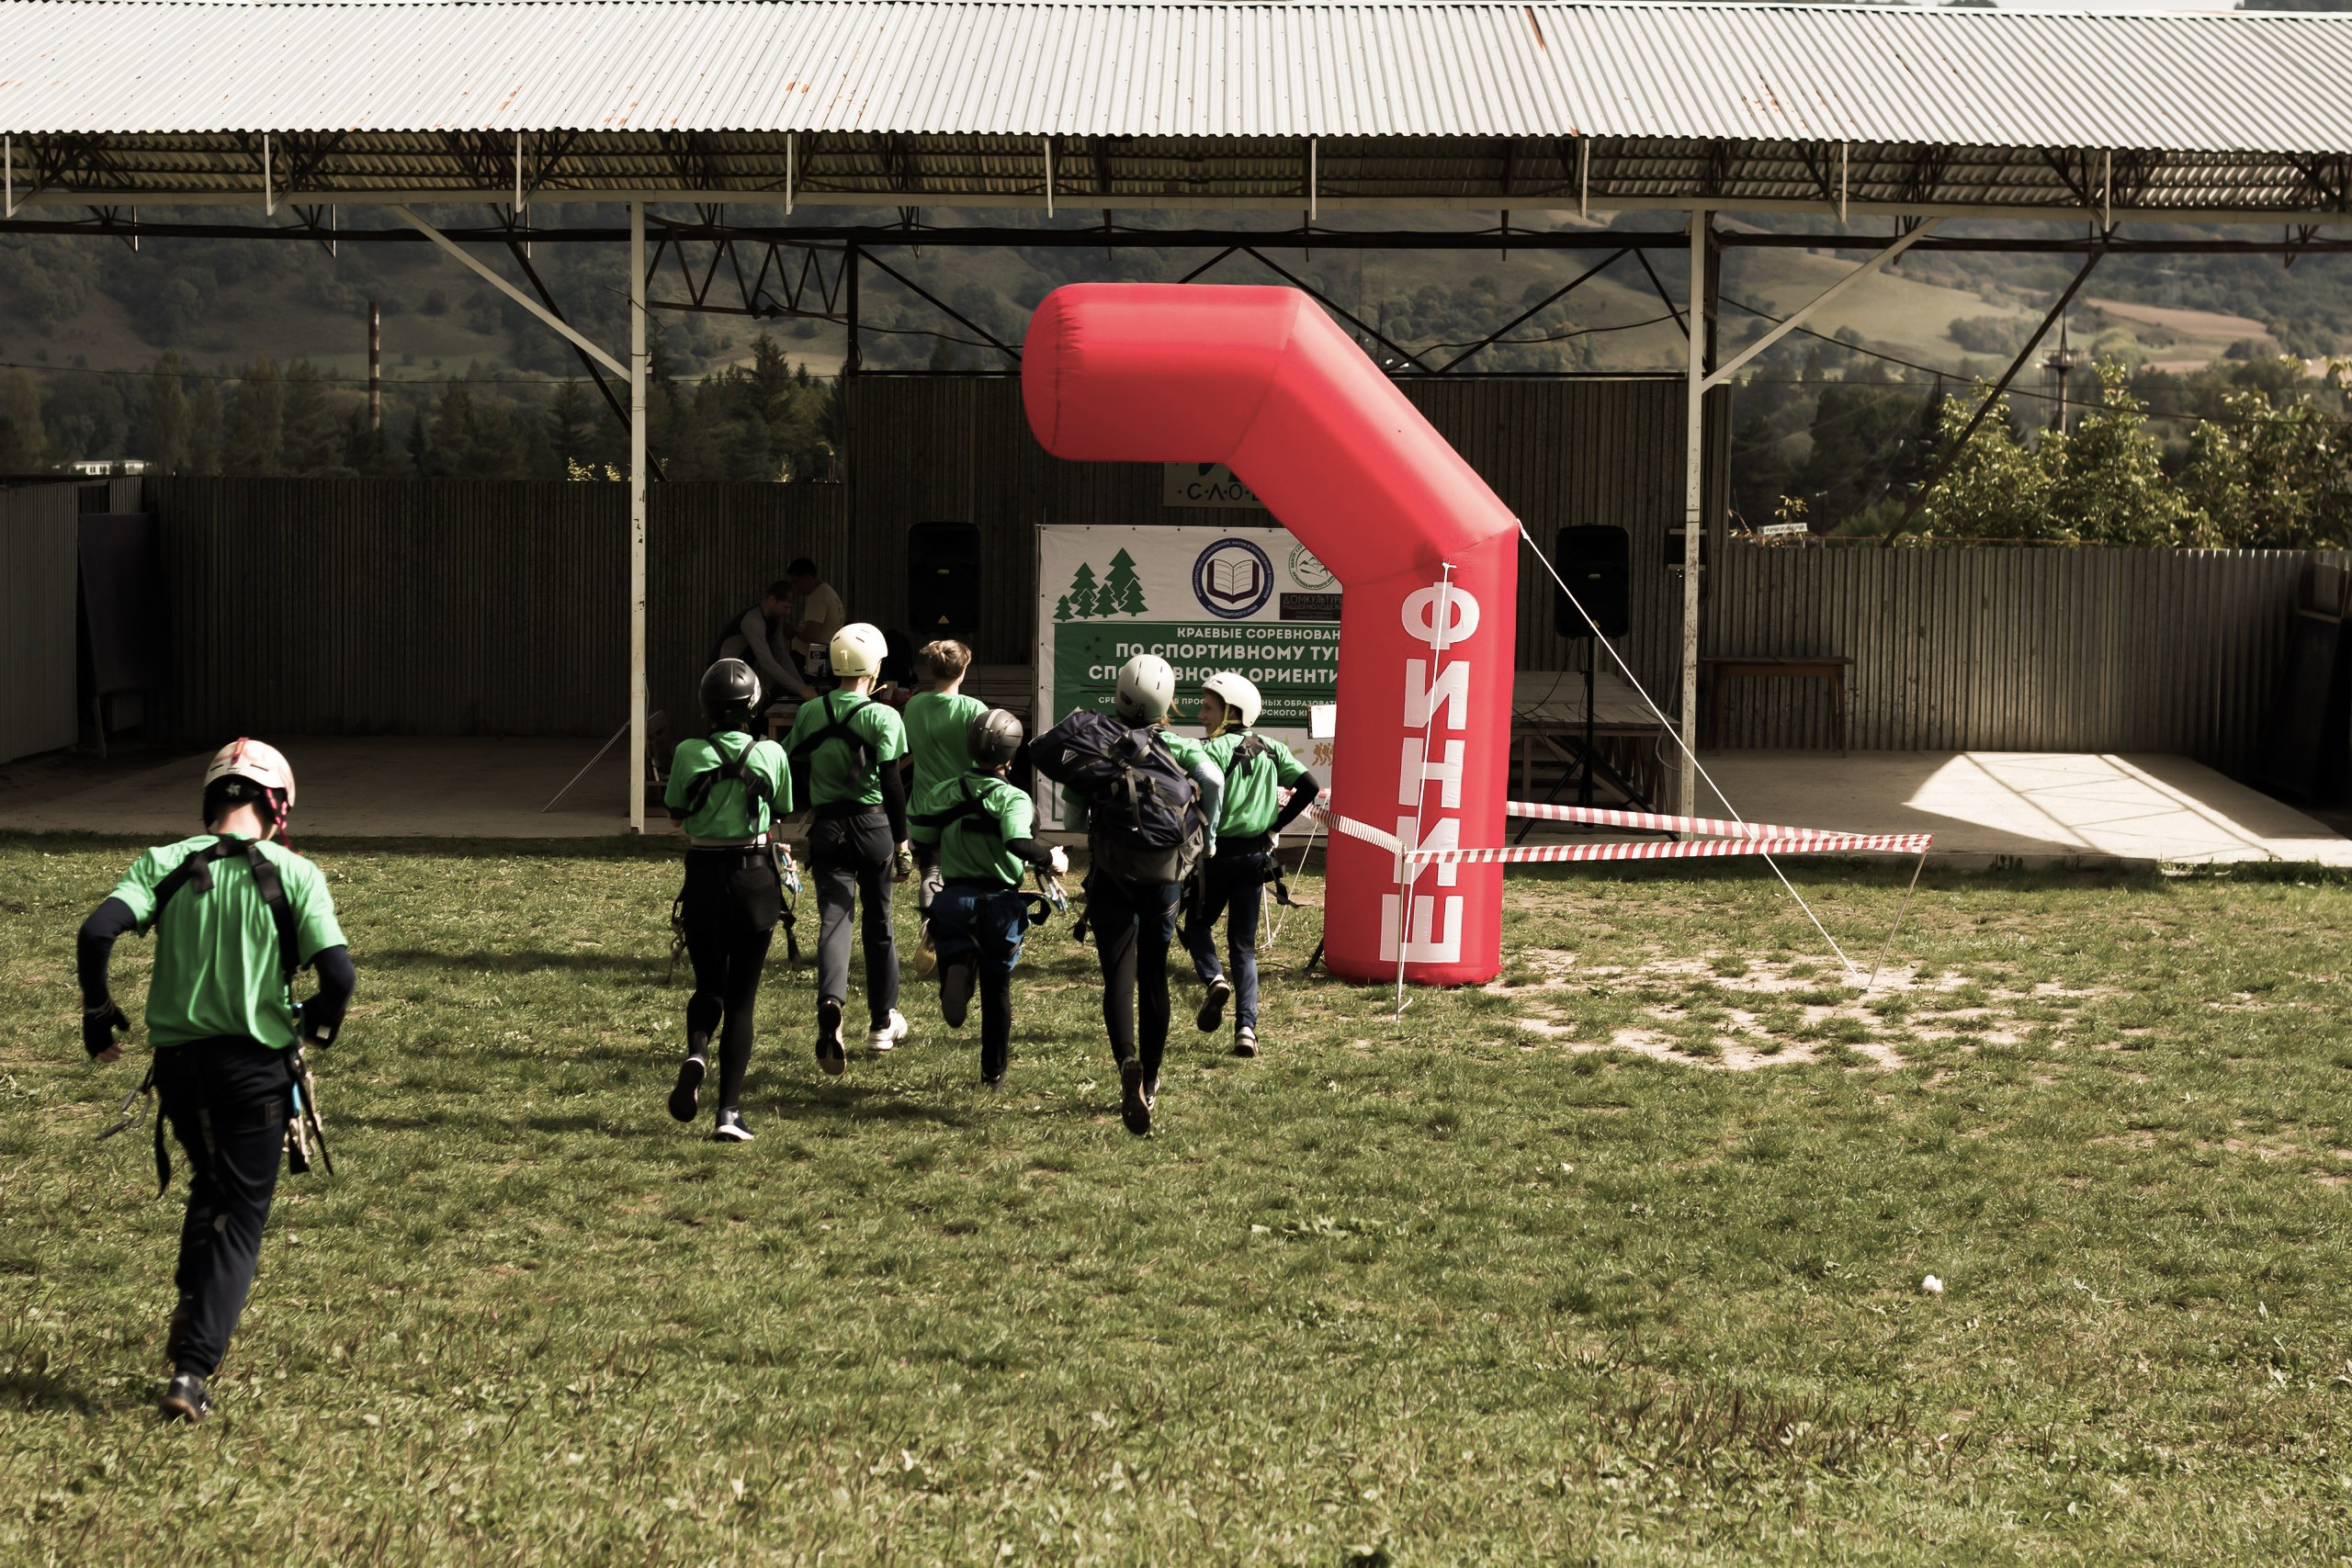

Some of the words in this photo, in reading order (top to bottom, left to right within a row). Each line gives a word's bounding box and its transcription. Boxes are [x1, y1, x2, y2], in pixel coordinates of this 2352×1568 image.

[1177, 627, 1242, 638] КРАЕВЫЕ
[1115, 643, 1145, 658] ПО
[1150, 643, 1306, 660] СПОРТИВНОМУ
[1379, 581, 1480, 964] ФИНИШ
